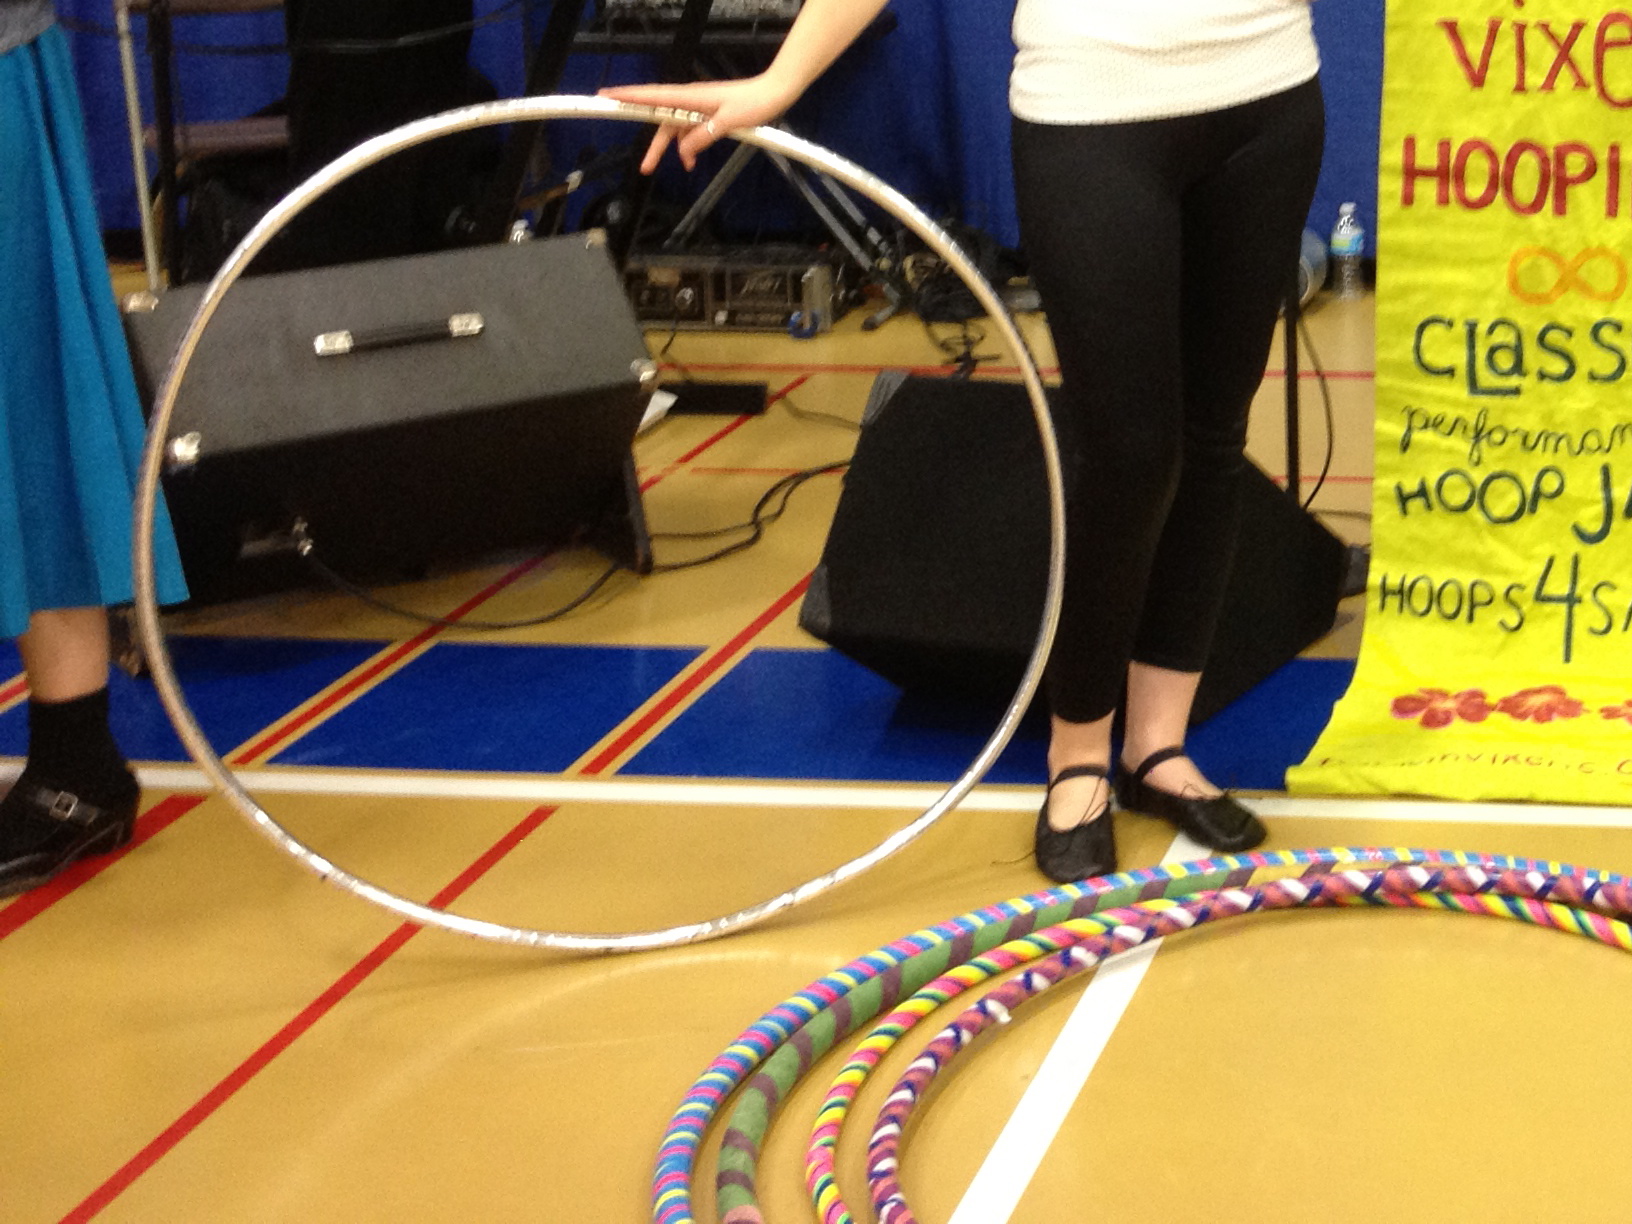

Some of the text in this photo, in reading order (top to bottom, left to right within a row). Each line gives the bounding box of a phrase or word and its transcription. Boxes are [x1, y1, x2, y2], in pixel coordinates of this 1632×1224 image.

[1393, 466, 1565, 525] HOOP
[1378, 572, 1527, 634] HOOPS
[1532, 551, 1583, 665] 4
